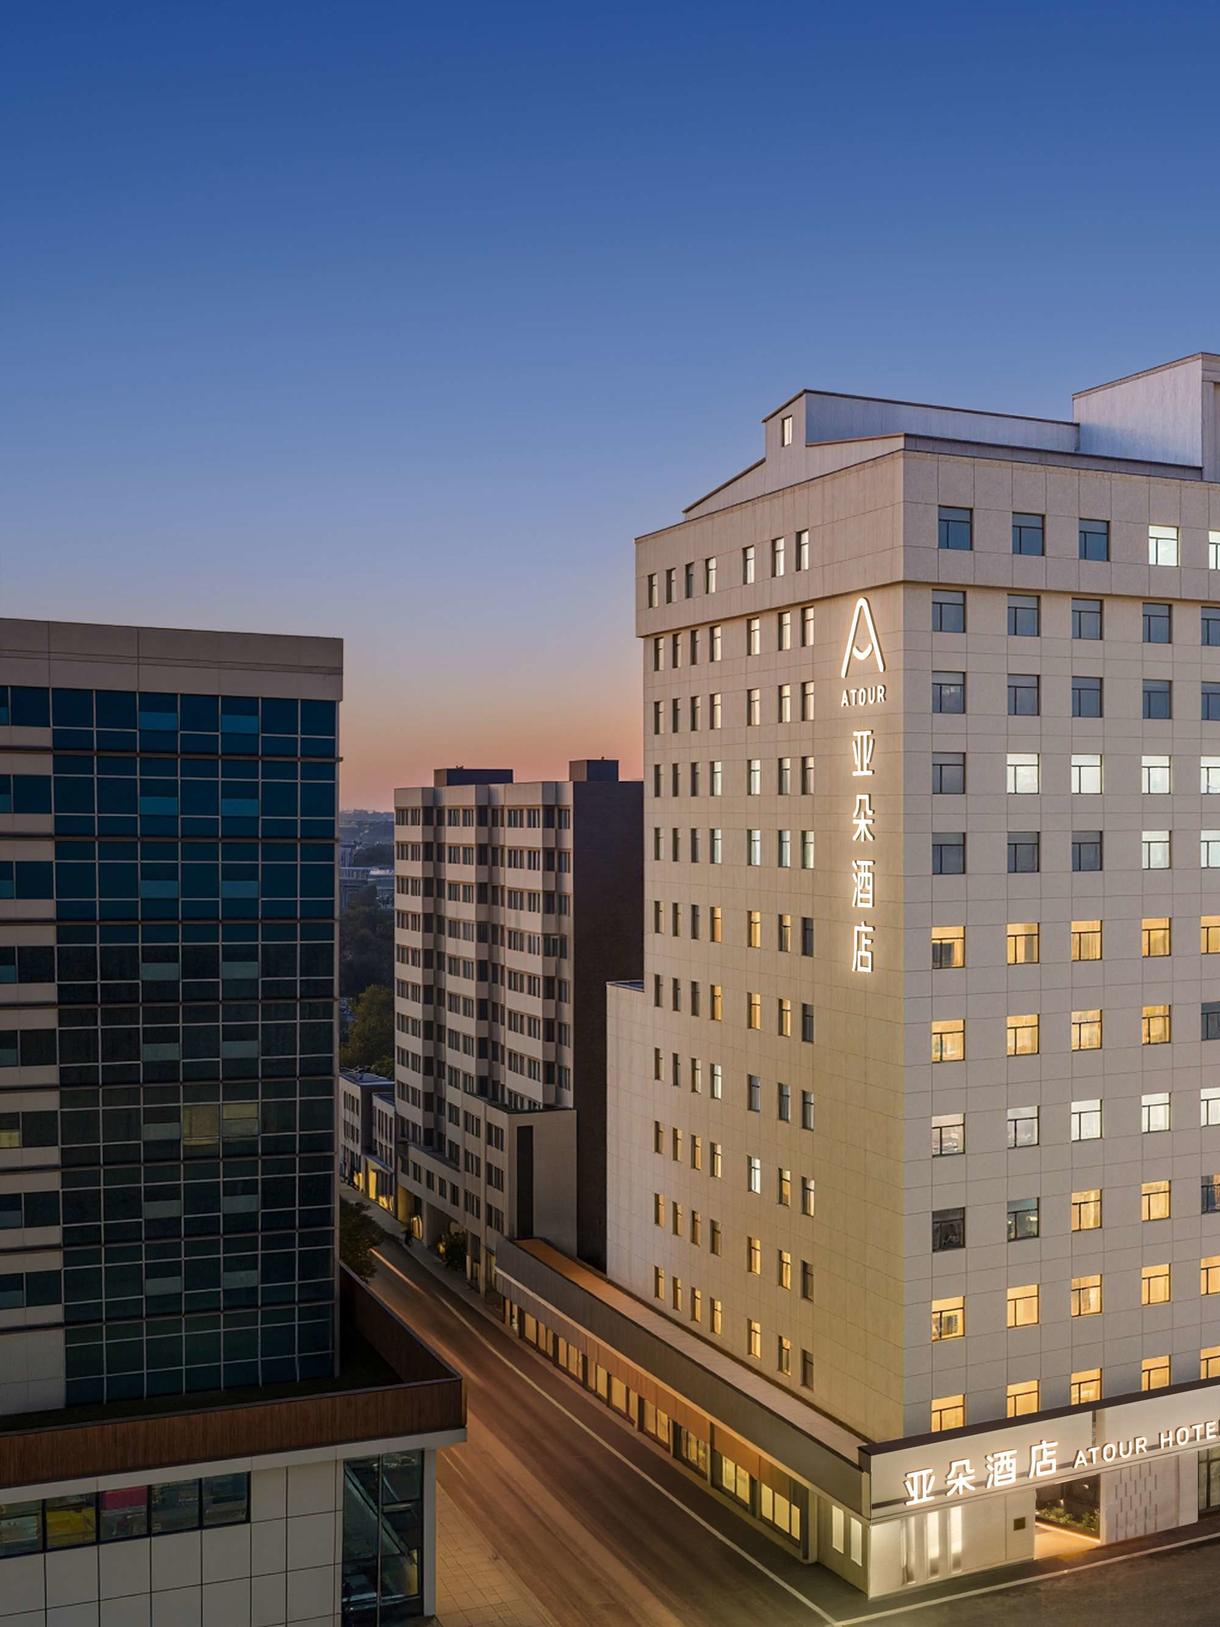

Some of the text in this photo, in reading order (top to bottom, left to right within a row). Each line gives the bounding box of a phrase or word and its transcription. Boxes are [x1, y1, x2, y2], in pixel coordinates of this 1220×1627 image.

[841, 684, 887, 708] ATOUR
[851, 729, 876, 974] 亚朵酒店
[903, 1440, 1059, 1506] 亚朵酒店
[1073, 1436, 1148, 1469] ATOUR
